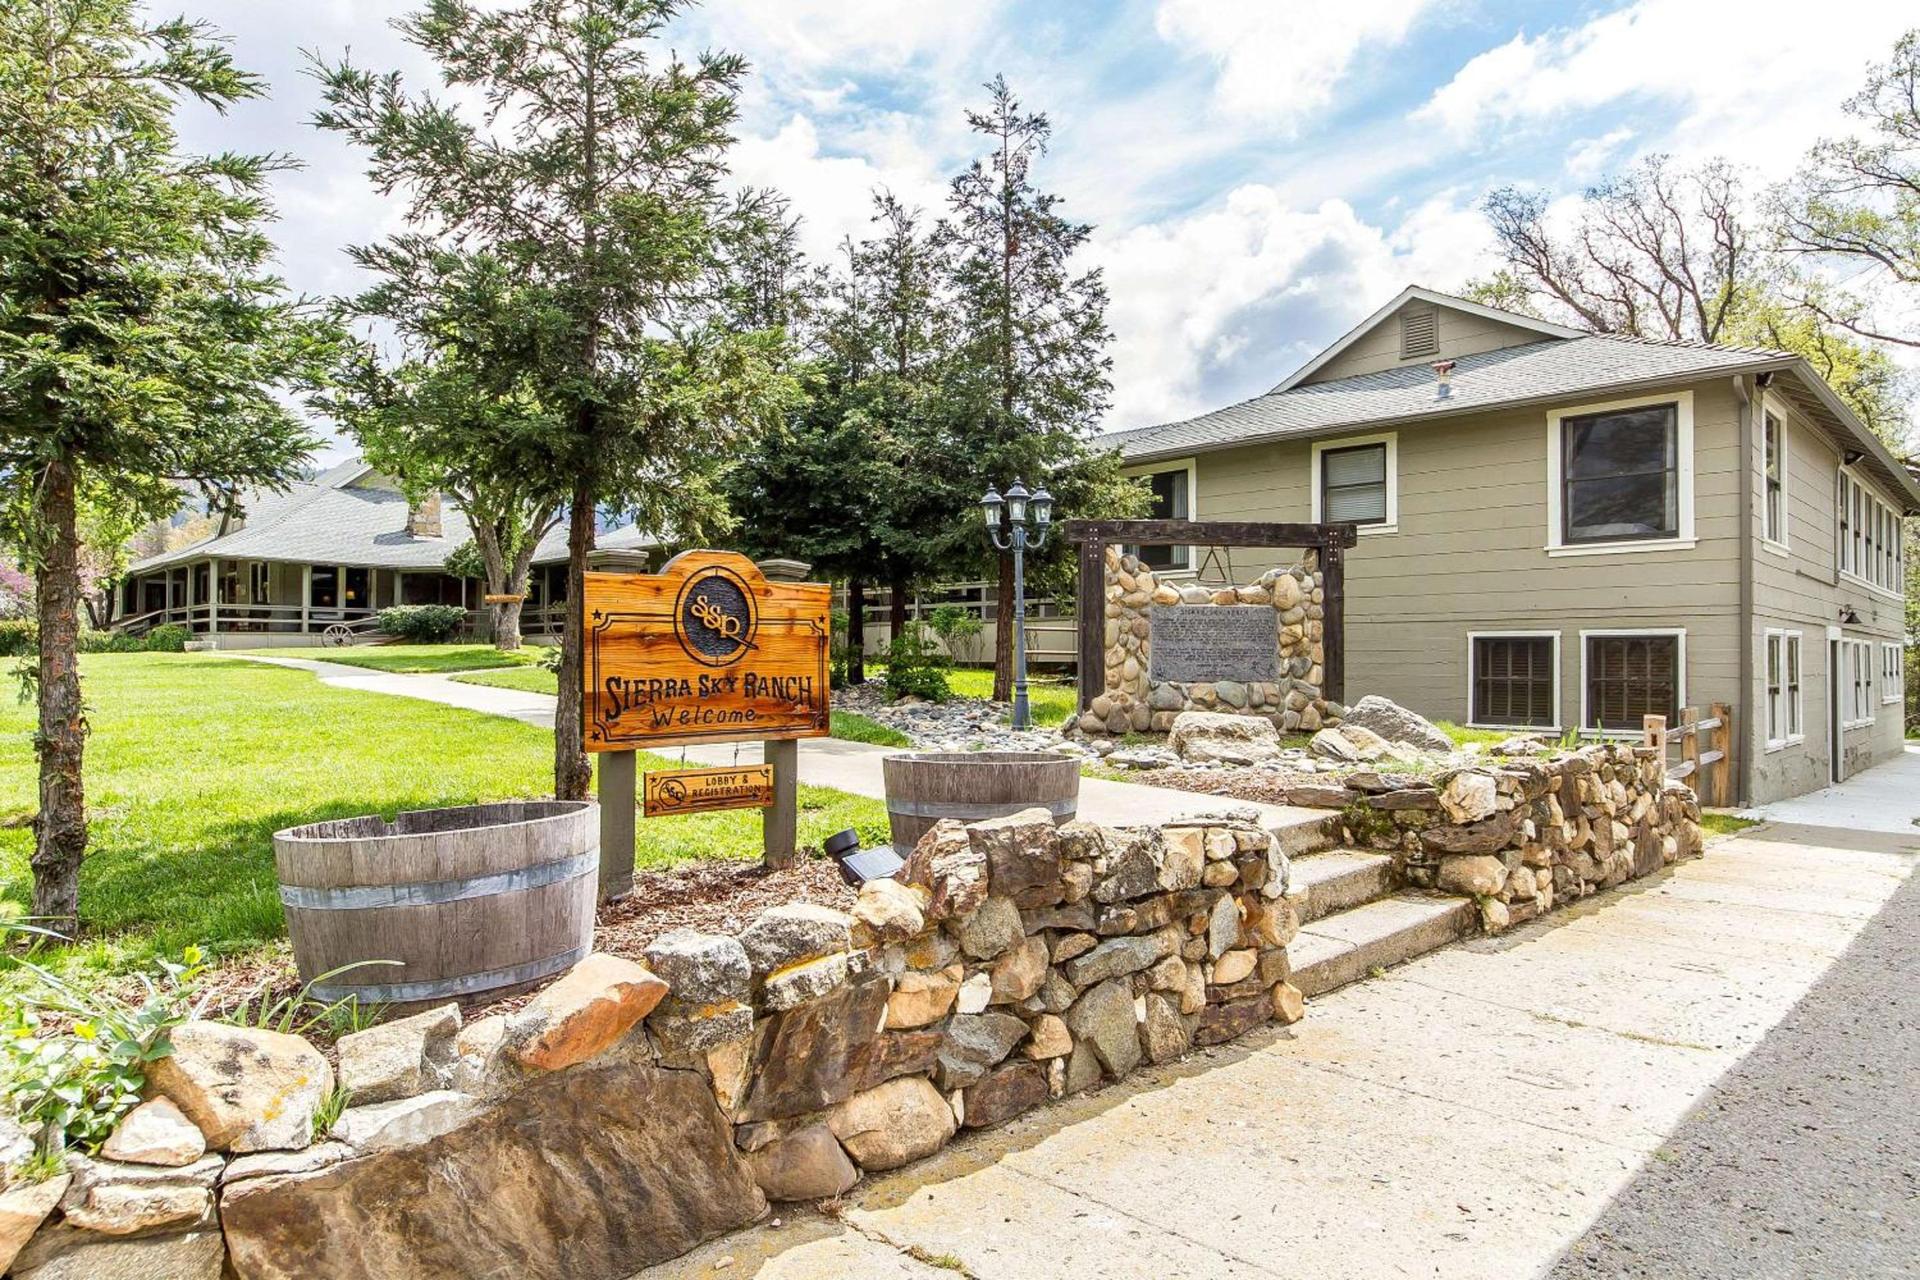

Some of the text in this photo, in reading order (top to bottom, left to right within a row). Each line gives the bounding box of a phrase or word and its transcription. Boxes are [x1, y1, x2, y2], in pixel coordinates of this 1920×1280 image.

[605, 671, 812, 722] SIERRA SKY RANCH
[652, 707, 756, 728] Welcome
[706, 776, 737, 787] LOBBY
[692, 785, 761, 798] REGISTRATION
